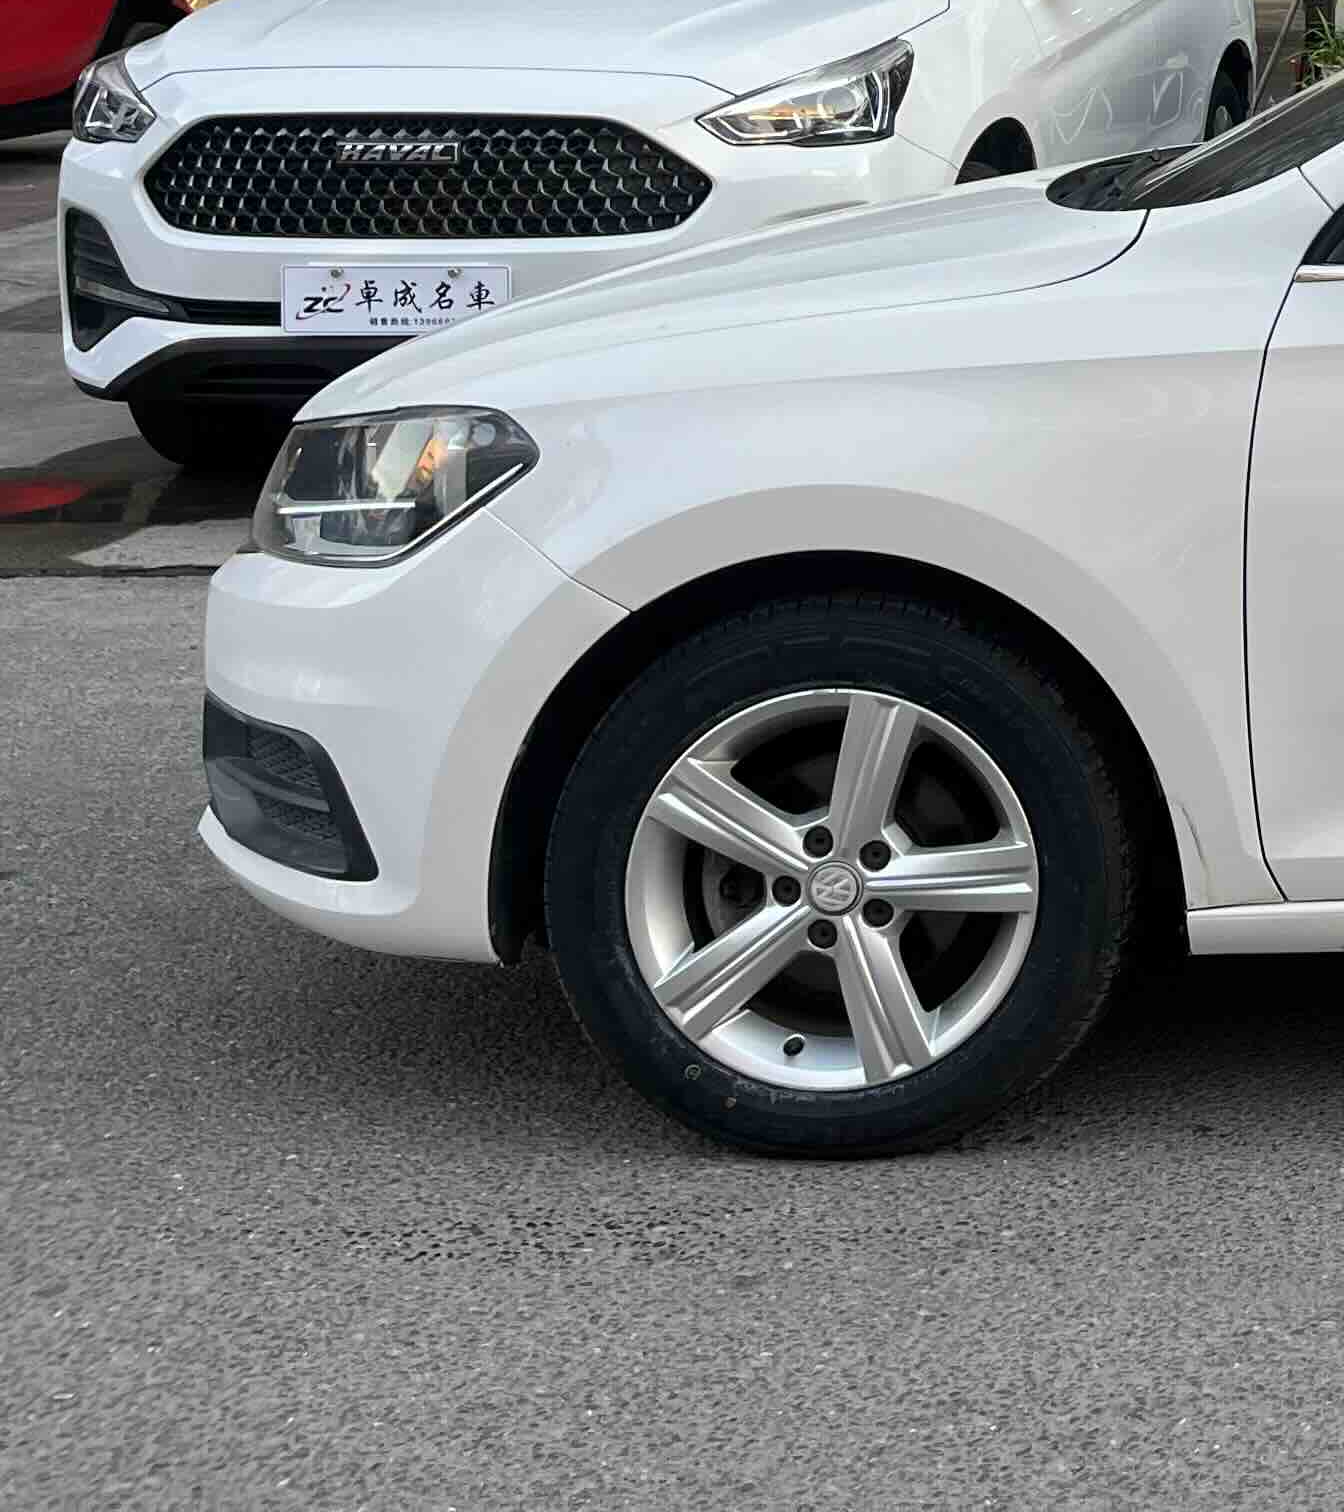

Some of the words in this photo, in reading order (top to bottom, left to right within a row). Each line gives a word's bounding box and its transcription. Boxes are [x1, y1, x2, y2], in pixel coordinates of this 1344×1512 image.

[340, 143, 451, 162] HAVAL
[354, 279, 496, 313] 卓成名車
